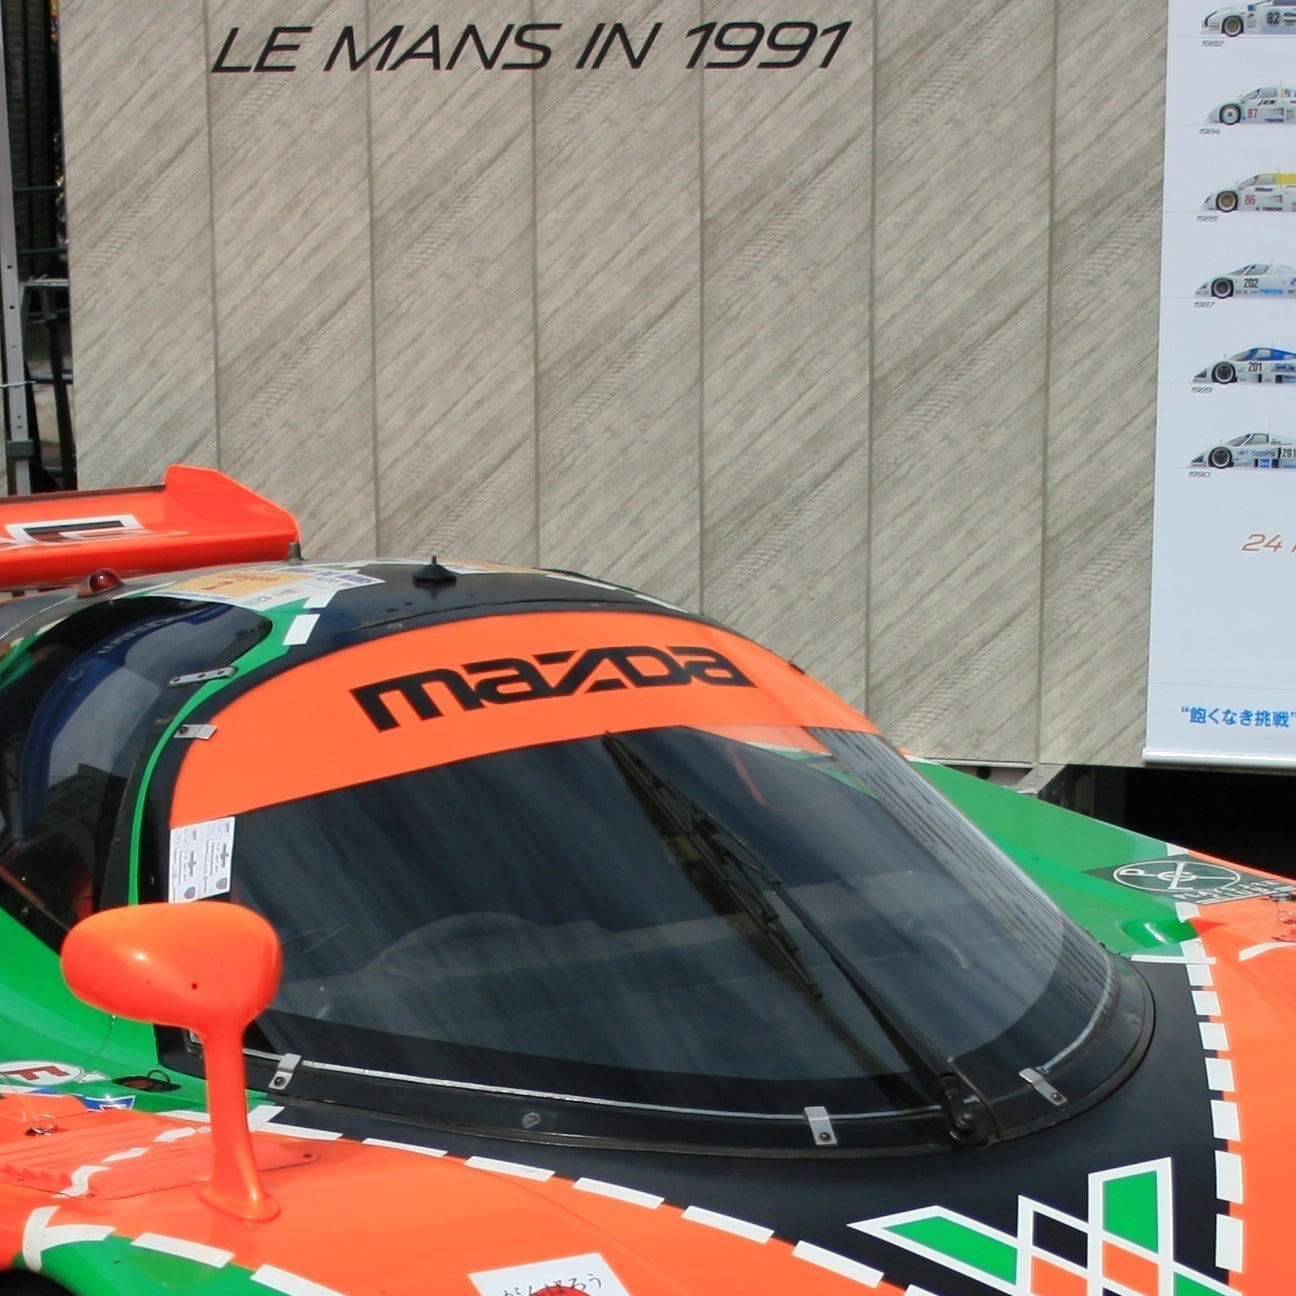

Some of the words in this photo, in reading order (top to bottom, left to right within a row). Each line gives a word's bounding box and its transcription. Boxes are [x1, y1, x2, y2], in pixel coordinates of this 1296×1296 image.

[1267, 11, 1280, 24] 82
[211, 26, 312, 73] LE
[322, 23, 562, 72] MANS
[574, 22, 664, 70] IN
[684, 21, 853, 69] 1991
[1243, 278, 1259, 288] 202
[1247, 362, 1262, 372] 201
[1282, 449, 1296, 459] 201
[1241, 534, 1282, 552] 24
[347, 645, 757, 733] mazda
